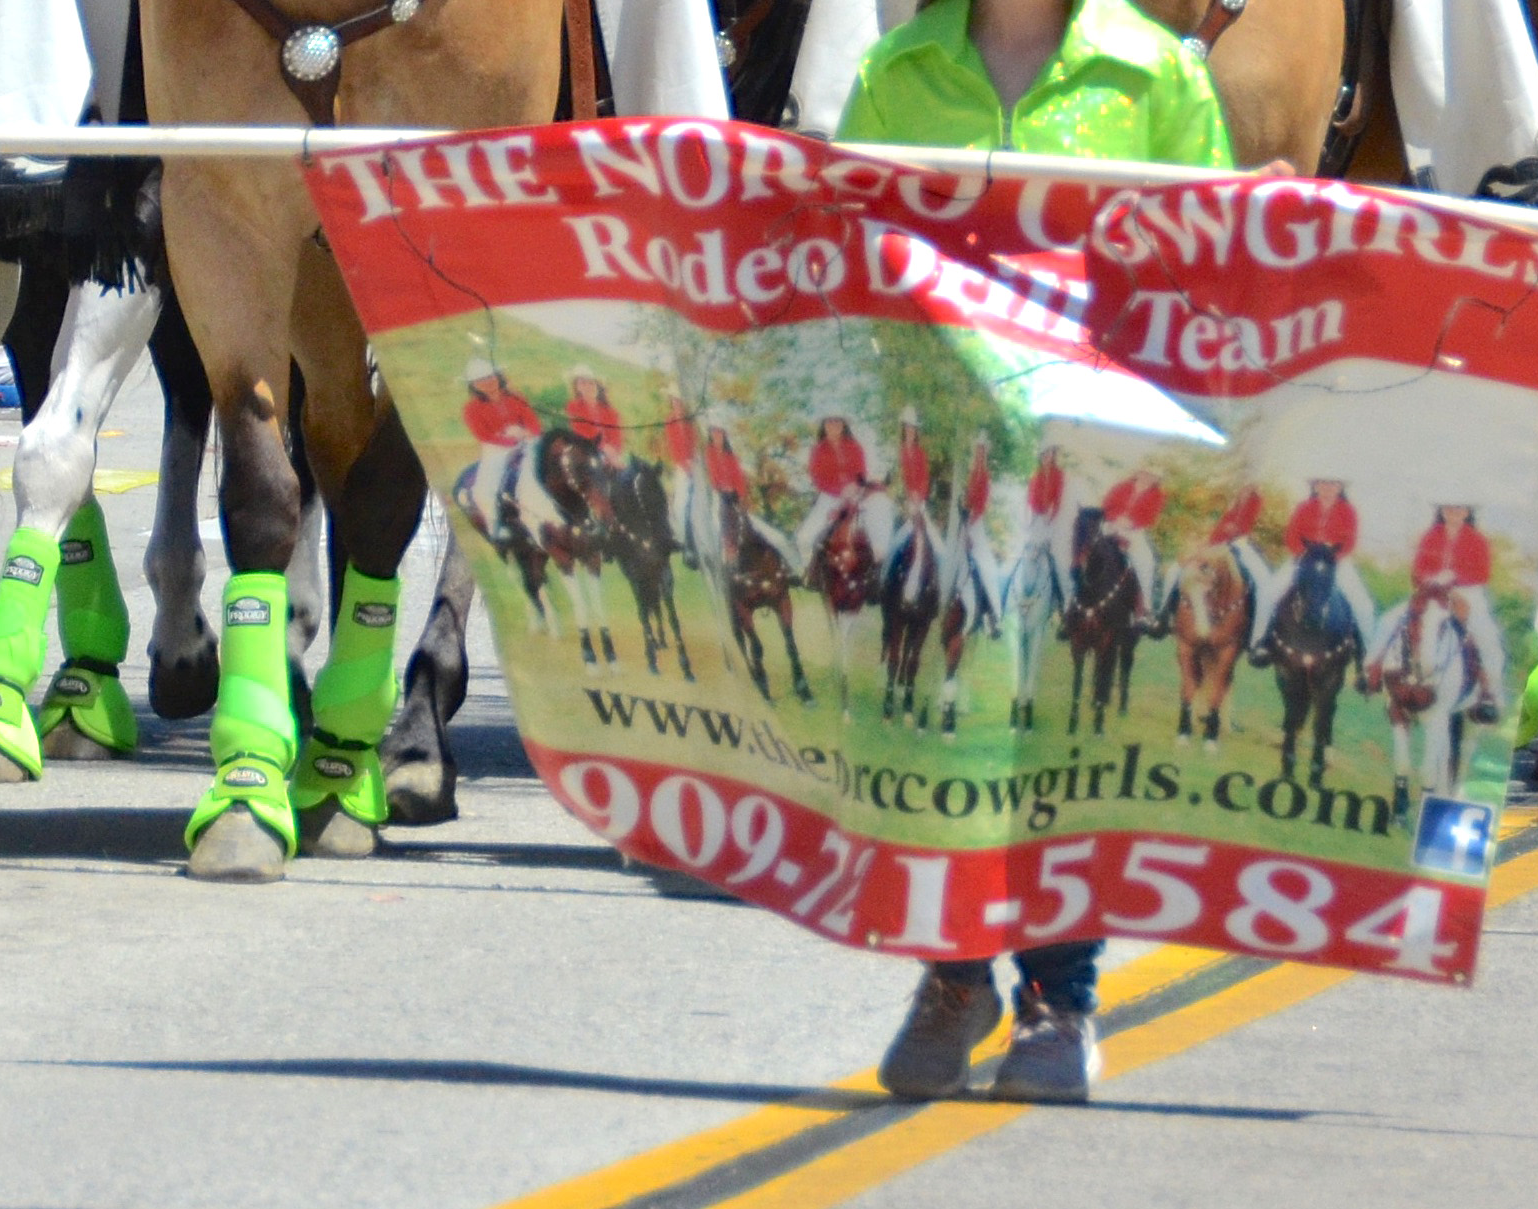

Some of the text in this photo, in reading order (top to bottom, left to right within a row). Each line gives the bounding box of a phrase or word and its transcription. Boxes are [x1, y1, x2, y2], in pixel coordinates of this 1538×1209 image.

[322, 135, 558, 224] THE
[572, 121, 987, 222] NORCO
[565, 214, 1345, 373] Rodeo Drill Team
[559, 760, 1460, 975] 909-721-5584
